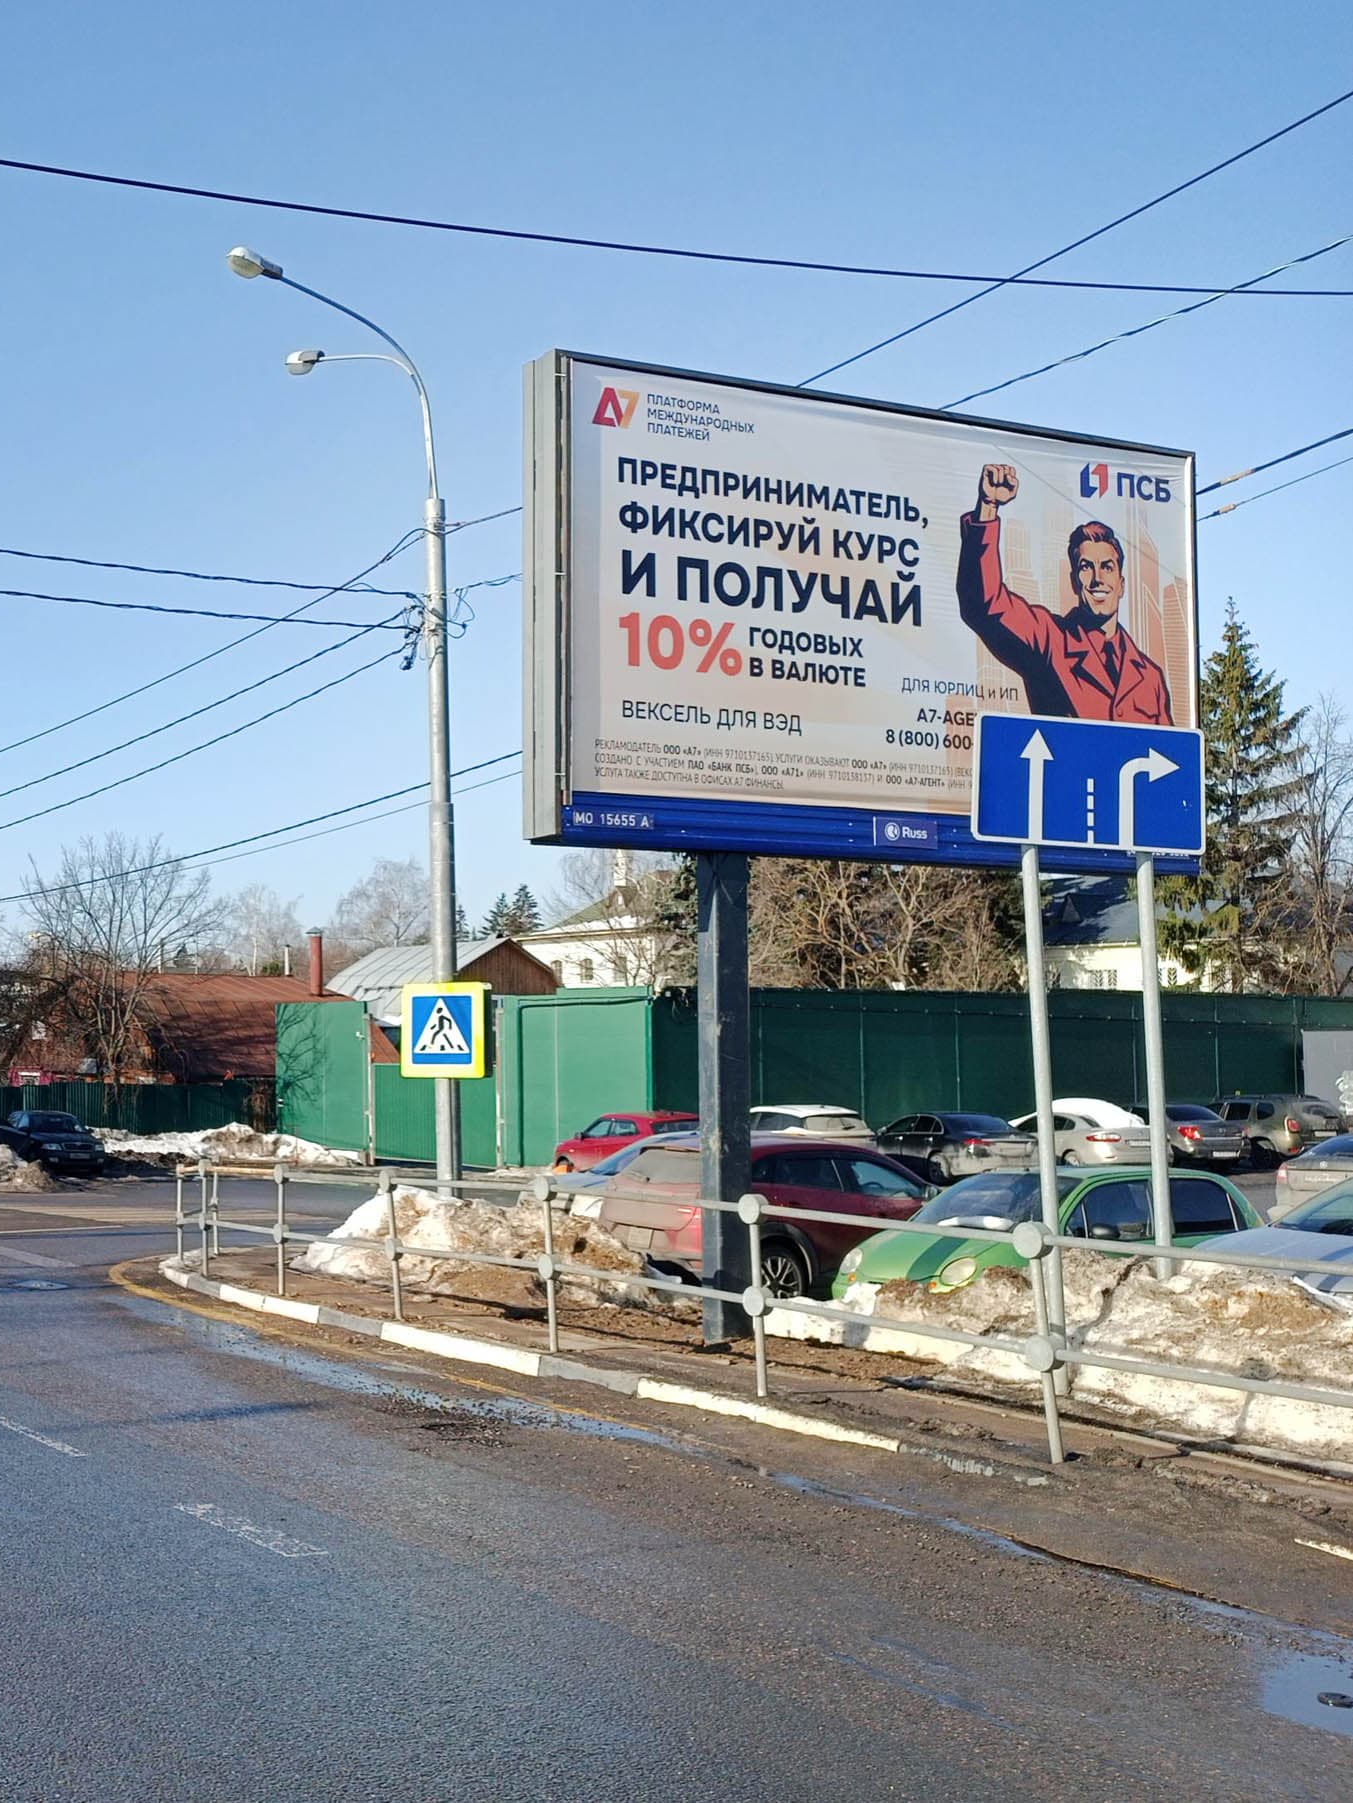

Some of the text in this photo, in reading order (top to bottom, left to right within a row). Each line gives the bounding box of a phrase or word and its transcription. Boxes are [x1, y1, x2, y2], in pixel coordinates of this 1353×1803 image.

[647, 393, 720, 414] ПЛАТФОРМА
[647, 408, 755, 434] МЕЖДУНАРОДНЫХ
[647, 422, 710, 441] ПЛАТЕЖЕЙ
[618, 456, 929, 529] ПРЕДПРИНИМАТЕЛЬ,
[1117, 472, 1171, 502] ПСБ
[618, 501, 920, 568] ФИКСИРУЙ КУРС
[621, 549, 922, 627] И ПОЛУЧАЙ
[619, 612, 743, 677] 10%
[749, 626, 864, 658] ГОДОВЫХ
[749, 657, 866, 687] В ВАЛЮТЕ
[901, 677, 930, 694] ДЛЯ
[934, 680, 985, 701] ЮРЛИЦ
[999, 687, 1018, 701] ИП
[622, 699, 802, 736] ВЕКСЕЛЬ ДЛЯ ВЭД
[917, 708, 978, 727] A7-AGE
[594, 739, 662, 755] РЕКЛАМОДАТЕЛЬ
[663, 744, 681, 755] ООО
[851, 759, 868, 770] ООО
[885, 729, 896, 744] 8
[898, 729, 940, 750] (800)
[594, 752, 633, 766] СОЗДАНО
[636, 755, 641, 766] С
[644, 756, 685, 769] УЧАСТИЕМ
[687, 759, 704, 770] ПАО
[761, 765, 778, 776] ООО
[885, 774, 902, 785] ООО
[651, 770, 693, 784] ДОСТУПНА
[600, 813, 636, 826] 15655
[902, 826, 928, 840] Russ
